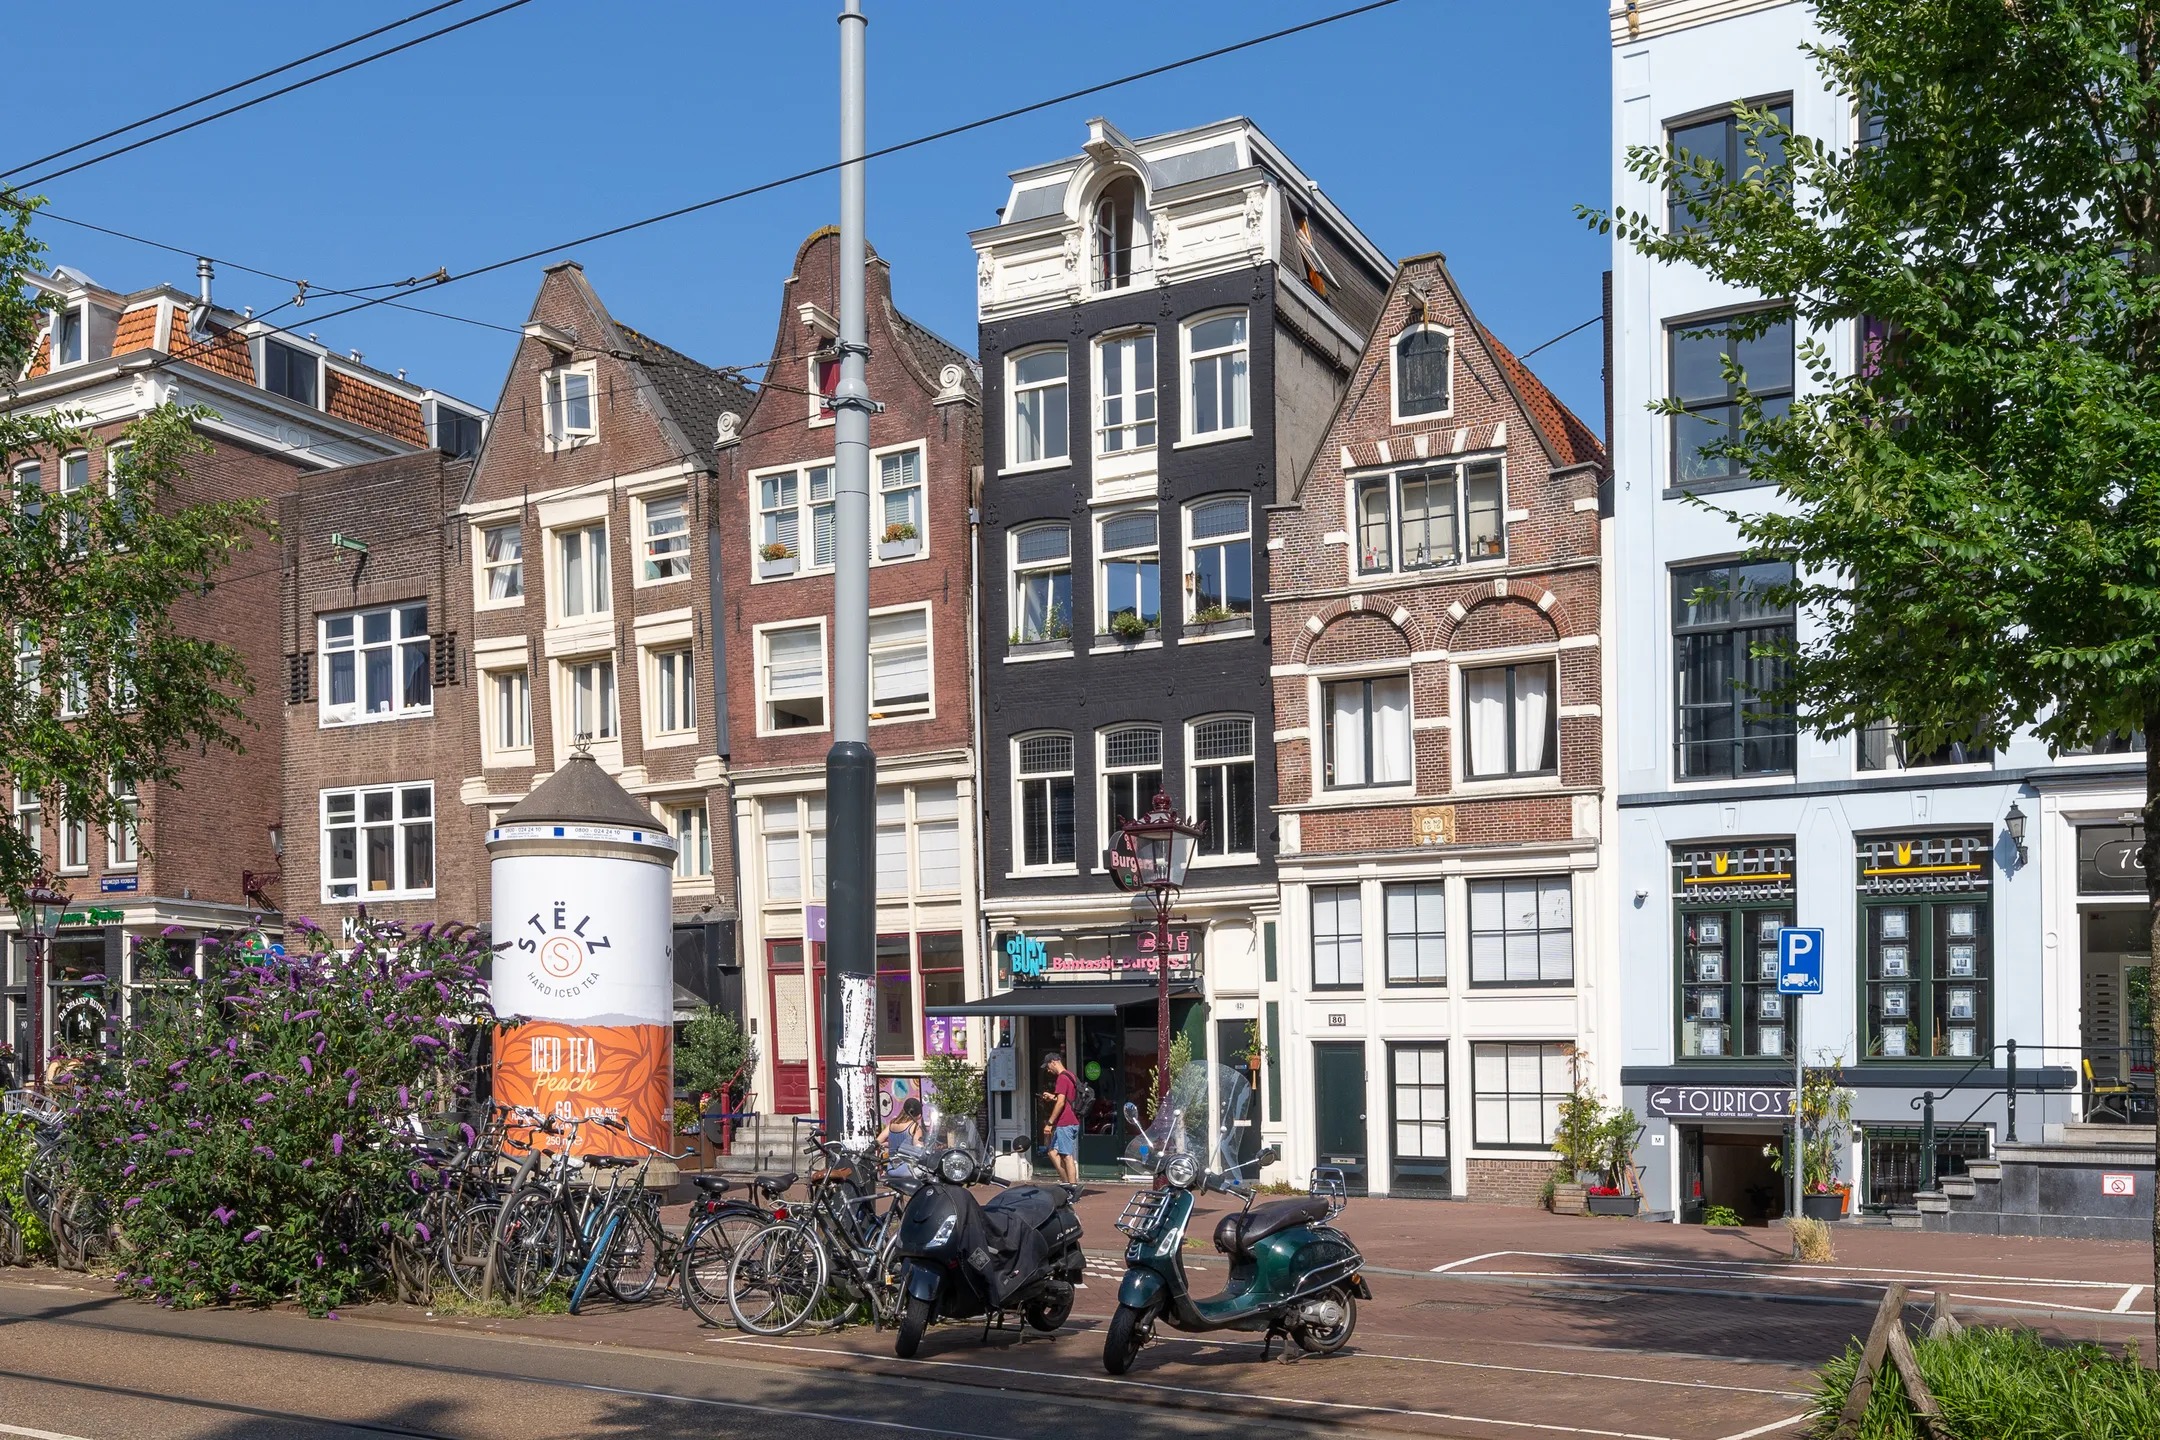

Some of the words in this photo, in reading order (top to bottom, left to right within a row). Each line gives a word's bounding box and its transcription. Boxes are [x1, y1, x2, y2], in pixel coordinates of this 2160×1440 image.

[1684, 848, 1792, 876] TULIP
[1863, 838, 1981, 868] TULIP
[1684, 883, 1789, 902] PROPERTY
[1866, 874, 1980, 895] PROPERTY
[518, 901, 611, 955] STËLZ
[1789, 934, 1813, 966] P
[527, 971, 552, 995] HARD
[554, 986, 581, 998] ICED
[581, 971, 600, 989] TEA
[20, 1021, 28, 1029] 90
[531, 1037, 561, 1072] ICED
[567, 1038, 596, 1073] TEA
[532, 1069, 598, 1096] Peach
[556, 1101, 572, 1120] 69
[1678, 1091, 1782, 1112] FOURNOS
[546, 1137, 560, 1145] 250
